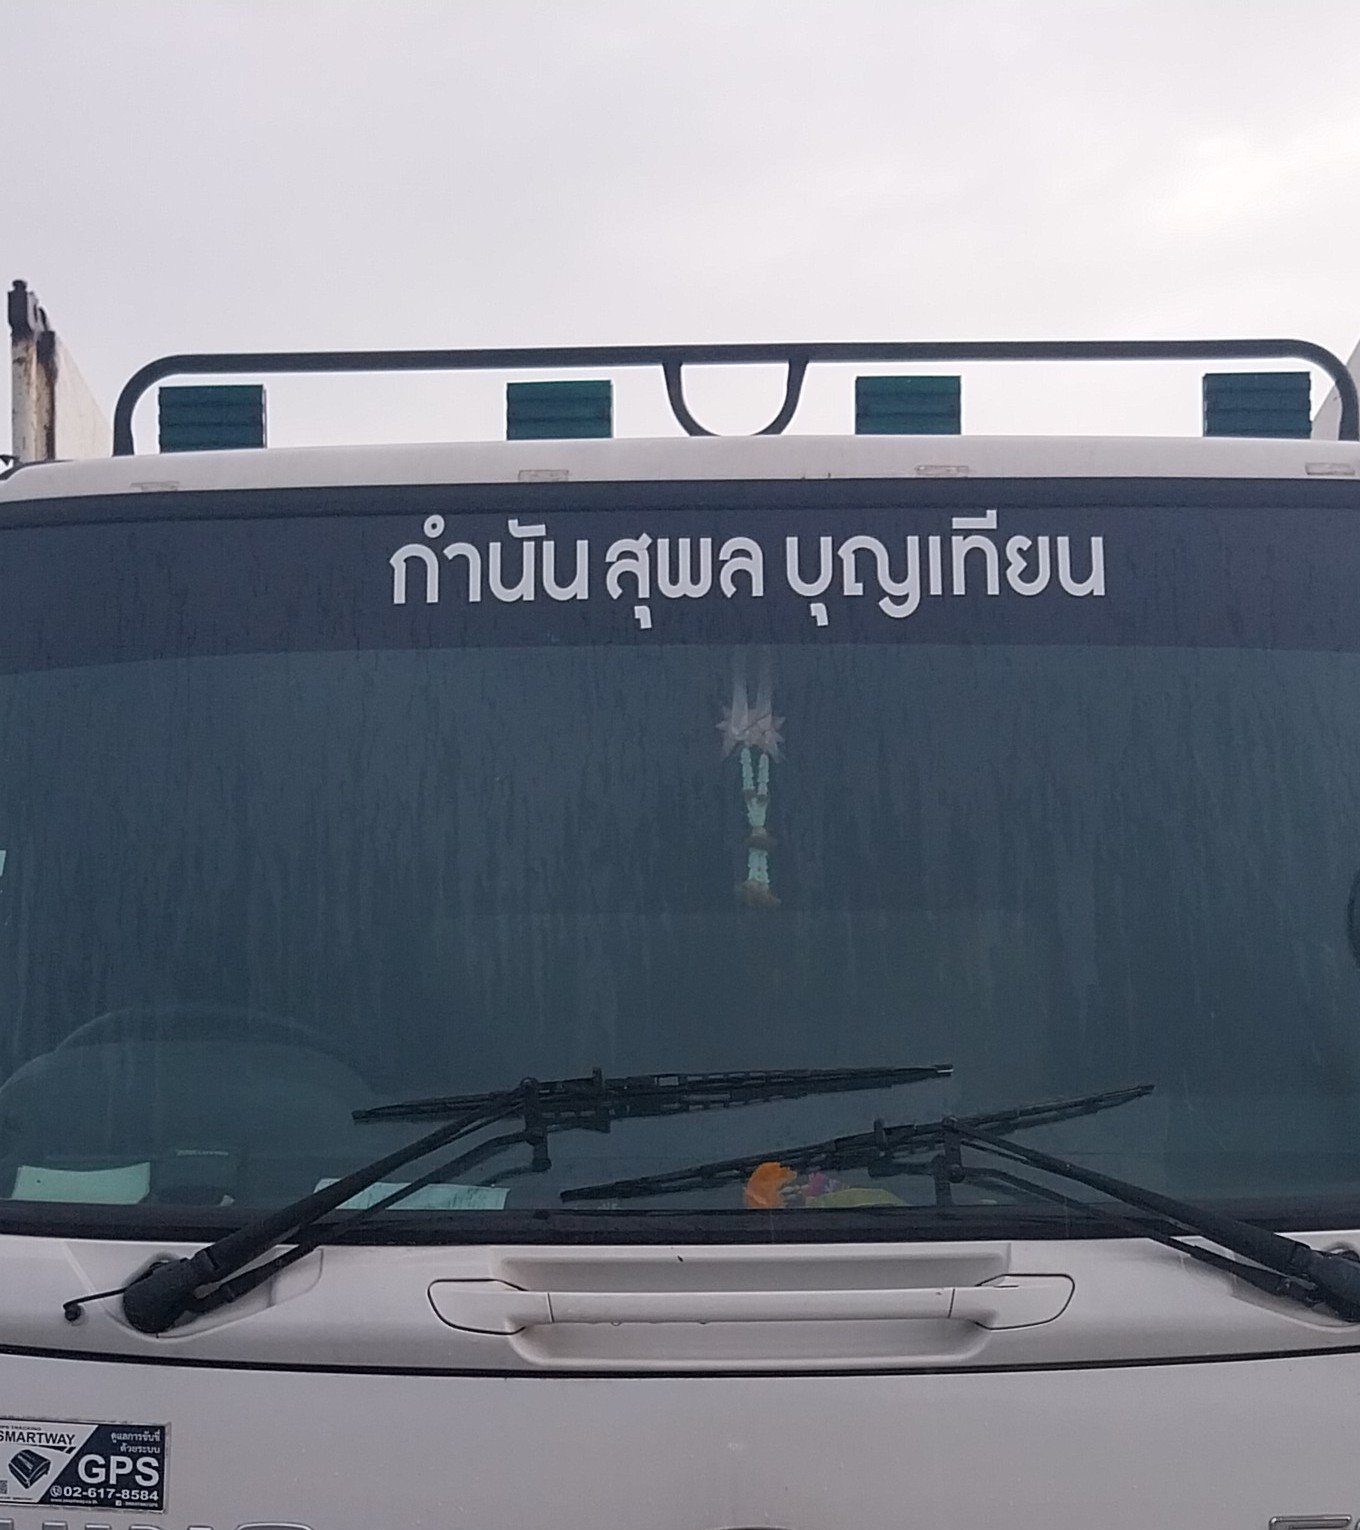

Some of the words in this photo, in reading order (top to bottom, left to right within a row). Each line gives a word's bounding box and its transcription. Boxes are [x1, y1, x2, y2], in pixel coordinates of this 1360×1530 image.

[389, 514, 589, 605] กำนัน
[604, 531, 764, 629] สุพล
[785, 509, 1106, 627] บุญเทียน
[77, 1454, 161, 1487] GPS
[63, 1486, 159, 1501] 02-617-8584
